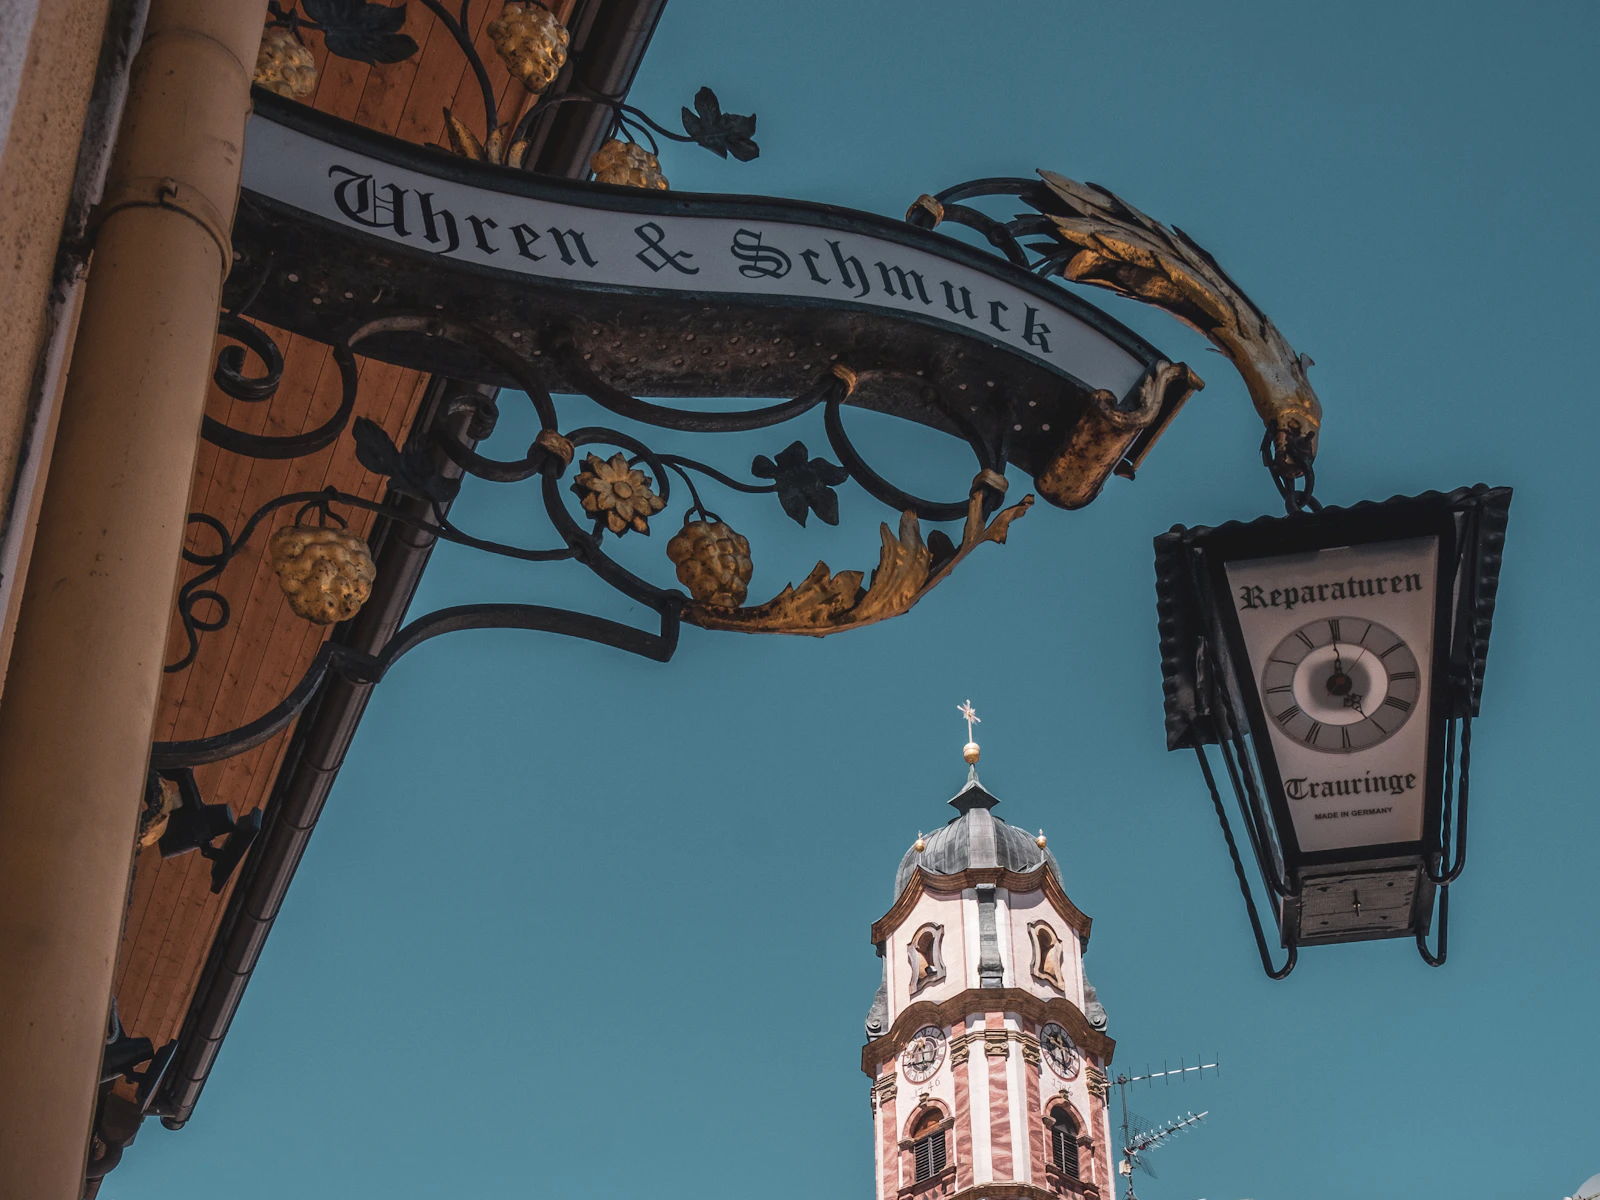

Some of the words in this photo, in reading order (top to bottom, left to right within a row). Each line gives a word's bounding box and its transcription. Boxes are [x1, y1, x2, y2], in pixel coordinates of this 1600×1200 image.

[328, 165, 599, 268] Uhren
[634, 221, 700, 276] &
[730, 228, 1054, 354] Schmuck
[1239, 573, 1423, 611] Reparaturen
[1284, 770, 1417, 800] Trauringe
[1314, 811, 1339, 820] MADE
[1351, 806, 1393, 817] GERMANY
